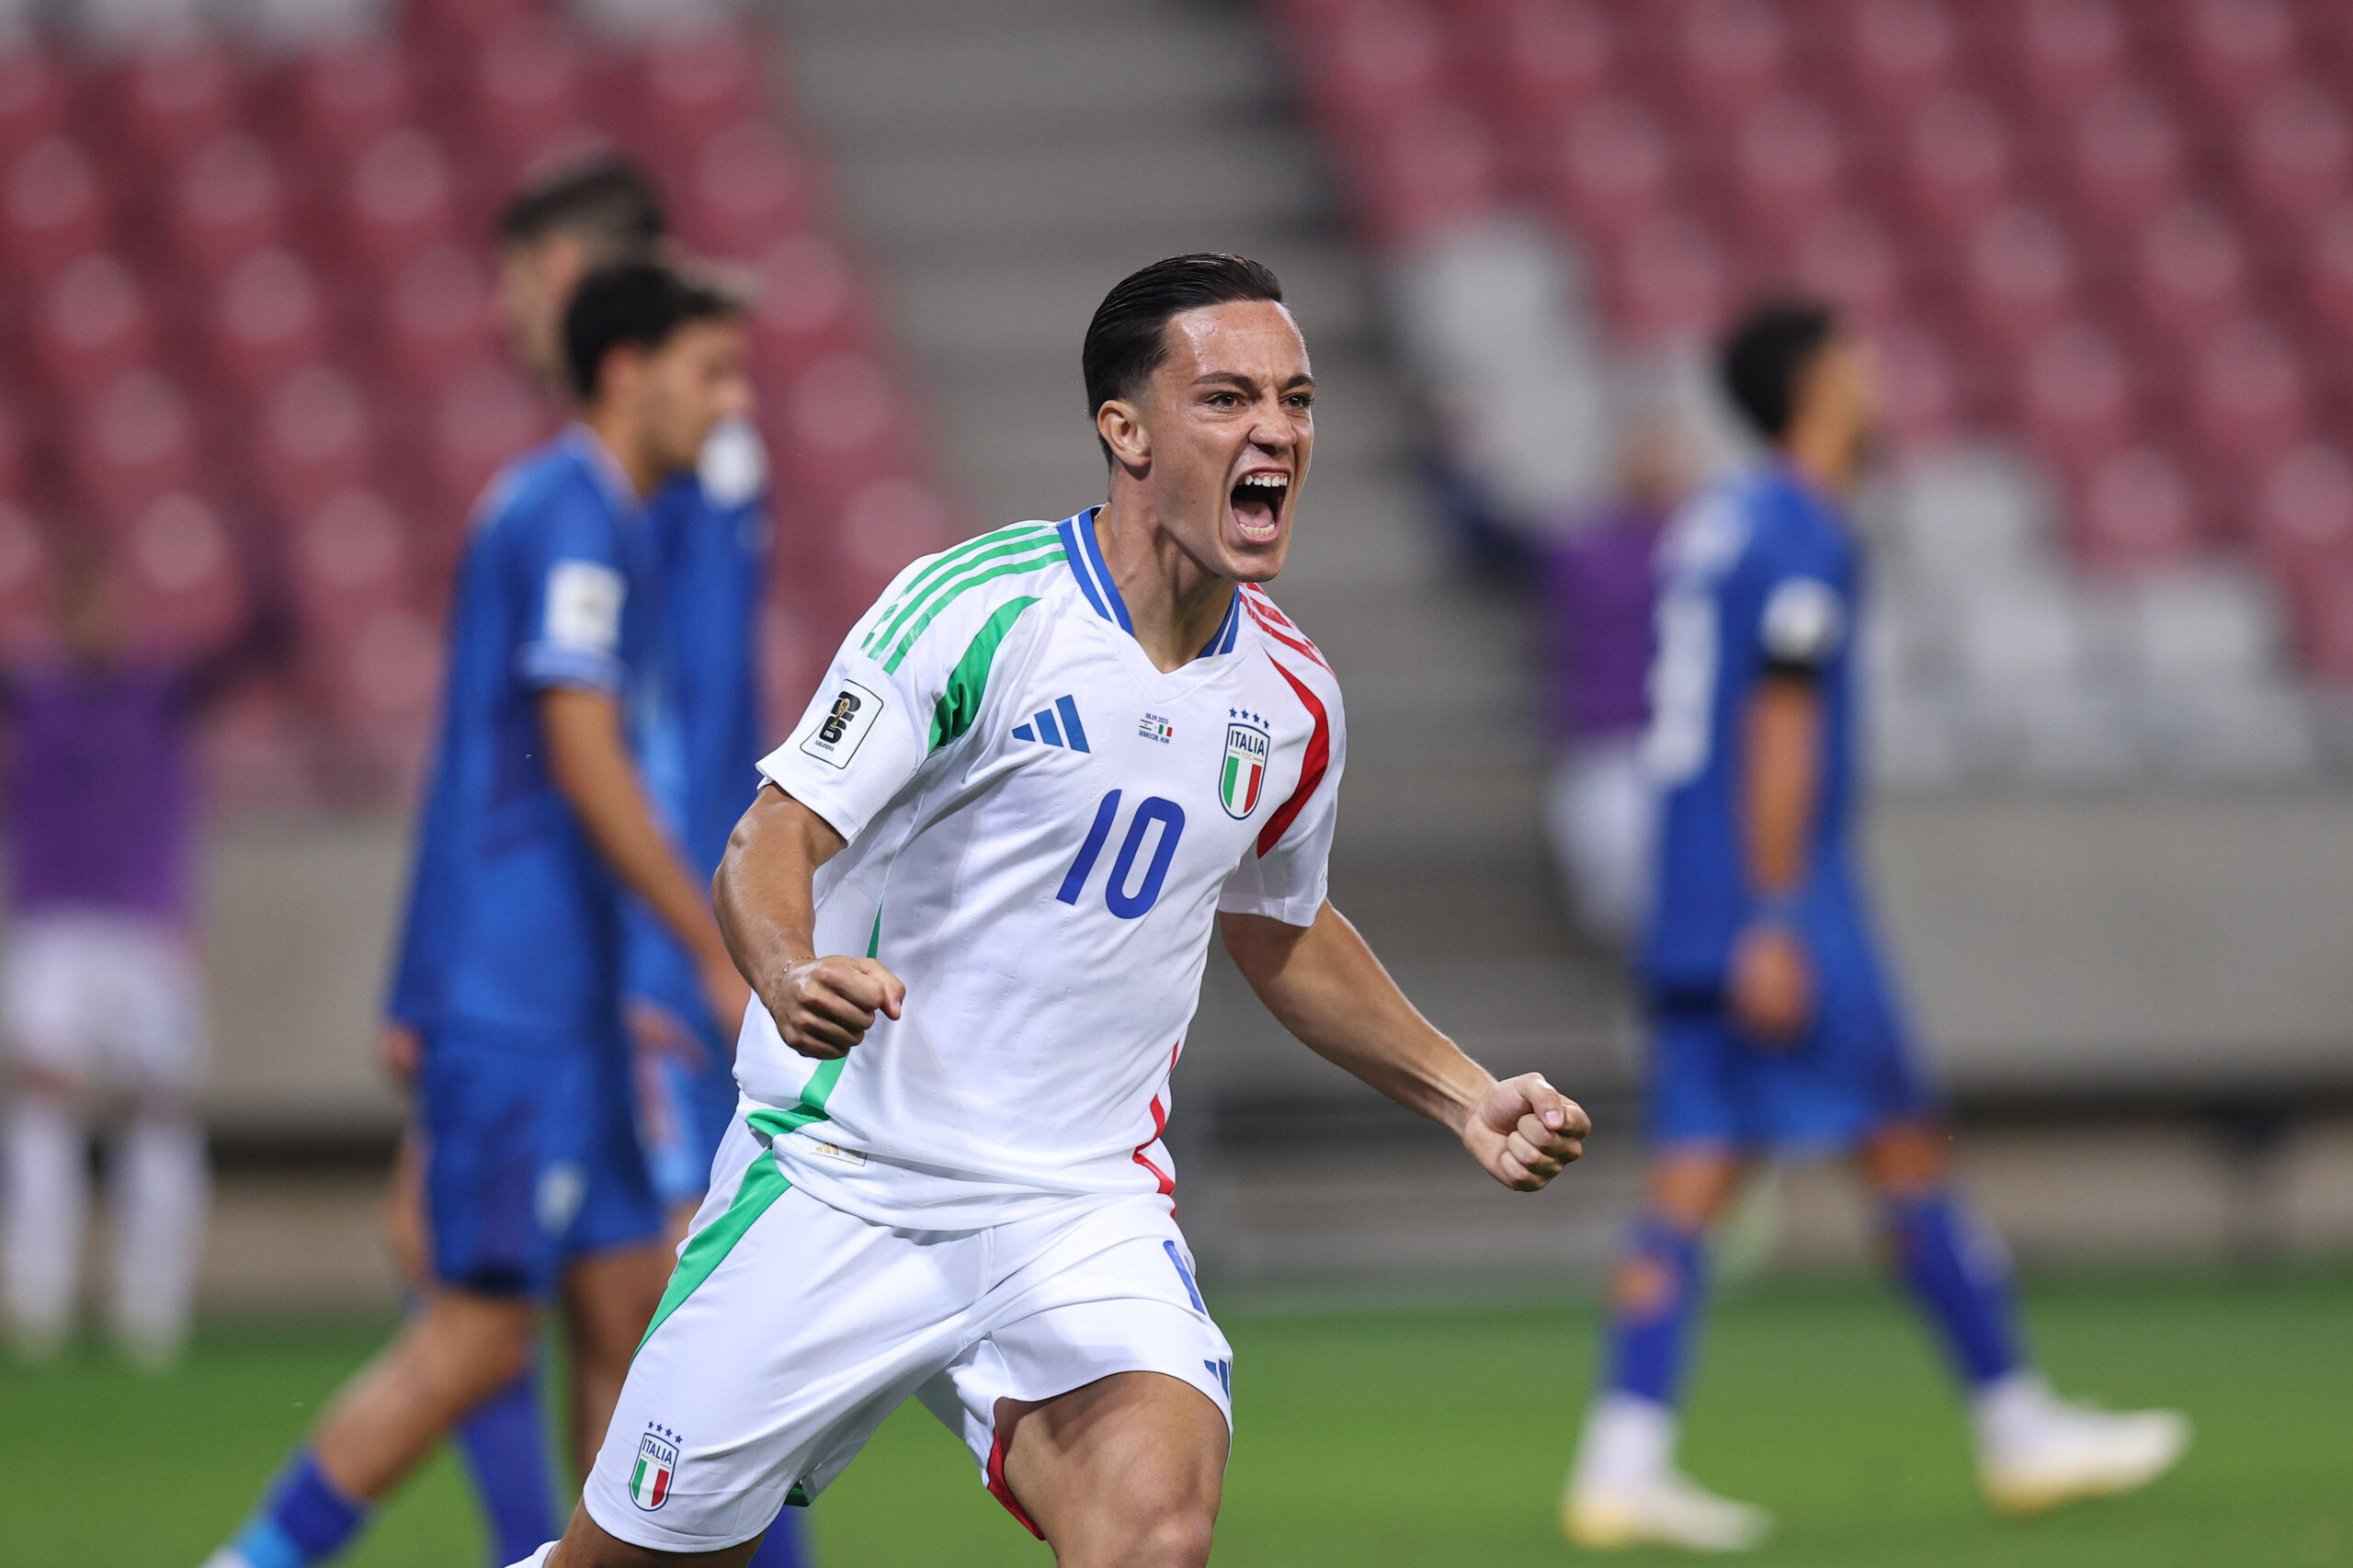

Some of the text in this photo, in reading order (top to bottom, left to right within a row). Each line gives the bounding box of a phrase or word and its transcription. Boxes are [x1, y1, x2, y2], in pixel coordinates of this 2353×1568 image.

[1230, 729, 1265, 756] ITALIA
[1055, 789, 1187, 920] 10
[642, 1438, 672, 1464] ITALIA
